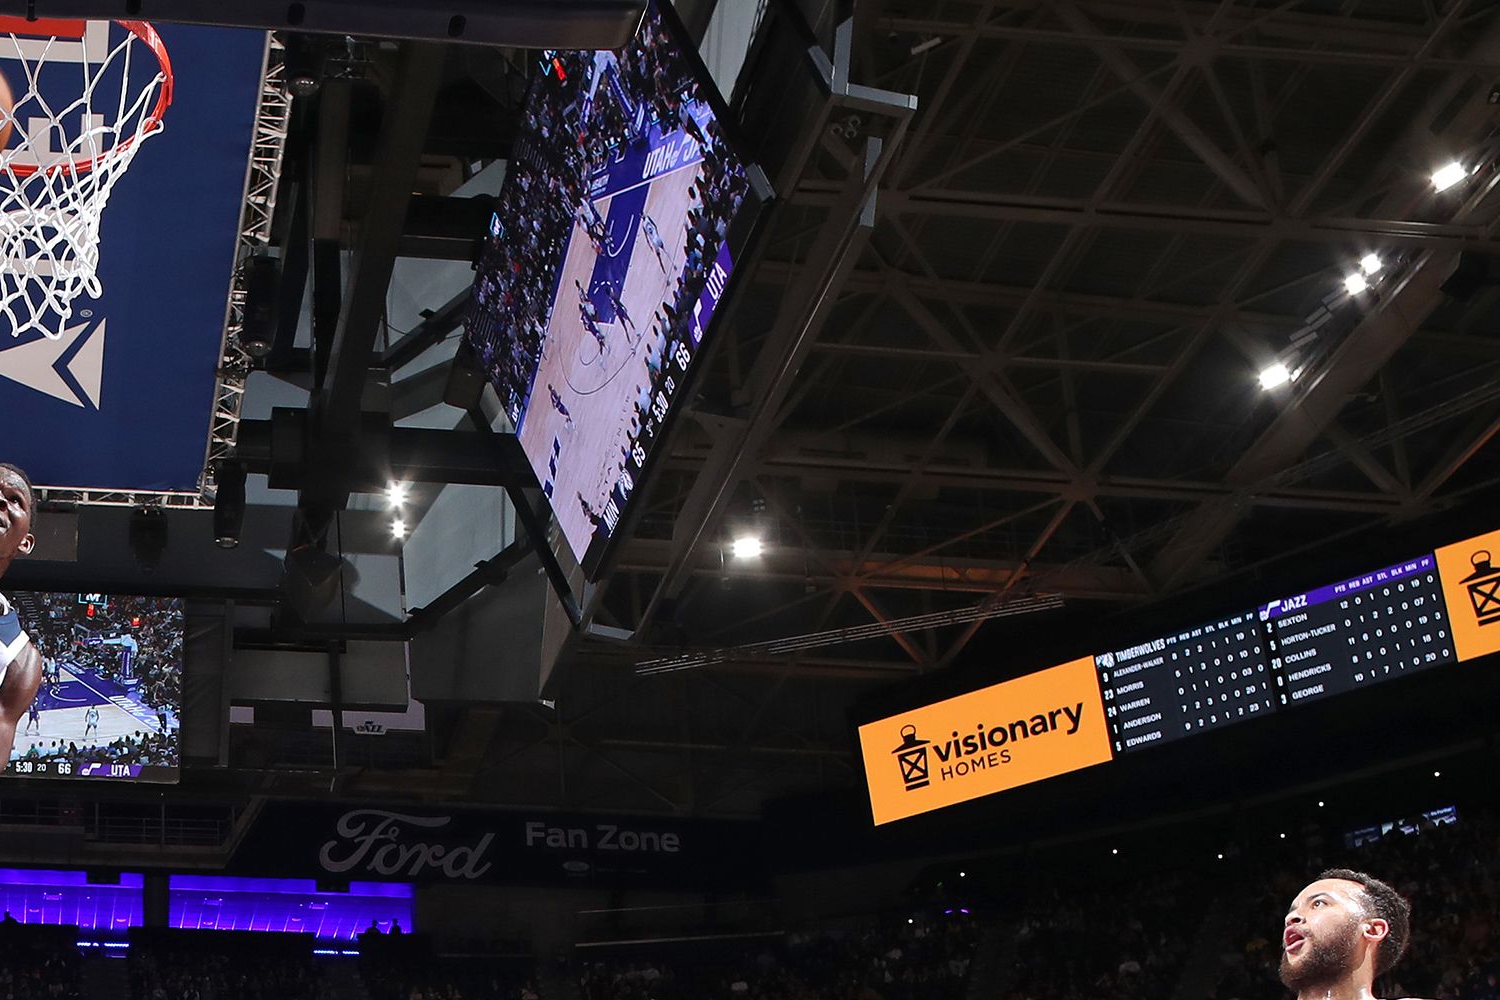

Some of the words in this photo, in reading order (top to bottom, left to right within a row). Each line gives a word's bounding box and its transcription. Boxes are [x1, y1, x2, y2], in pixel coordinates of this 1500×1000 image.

[603, 498, 620, 531] MIN
[632, 441, 646, 467] 65
[652, 391, 669, 424] 5:30
[665, 377, 675, 396] 20
[676, 342, 691, 372] 66
[705, 262, 727, 299] UTA
[1281, 595, 1308, 613] JAZZ
[1266, 623, 1273, 634] 2
[1278, 613, 1308, 629] SEXTON
[1270, 641, 1276, 651] 5
[1281, 624, 1336, 647] HORTON-TUCKER
[1115, 638, 1166, 662] TIMBERWOLVES
[1272, 658, 1282, 669] 20
[1285, 649, 1317, 664] COLLINS
[1289, 663, 1331, 682] HENDRICKS
[1104, 689, 1114, 700] 23
[1117, 681, 1144, 695] MORRIS
[1281, 694, 1287, 704] 3
[1292, 684, 1324, 700] GEORGE
[1108, 707, 1118, 717] 24
[1120, 698, 1151, 712] WARREN
[1124, 713, 1162, 729] ANDERSON
[933, 702, 1083, 762] visionary
[1116, 741, 1122, 752] 5
[1127, 731, 1162, 747] EDWARDS
[16, 762, 33, 773] 5:30
[37, 764, 46, 772] 20
[58, 763, 71, 774] 66
[111, 765, 130, 776] UTA
[941, 749, 1012, 781] HOMES
[319, 809, 495, 879] Ford
[526, 822, 588, 849] Fan
[596, 824, 681, 851] Zone
